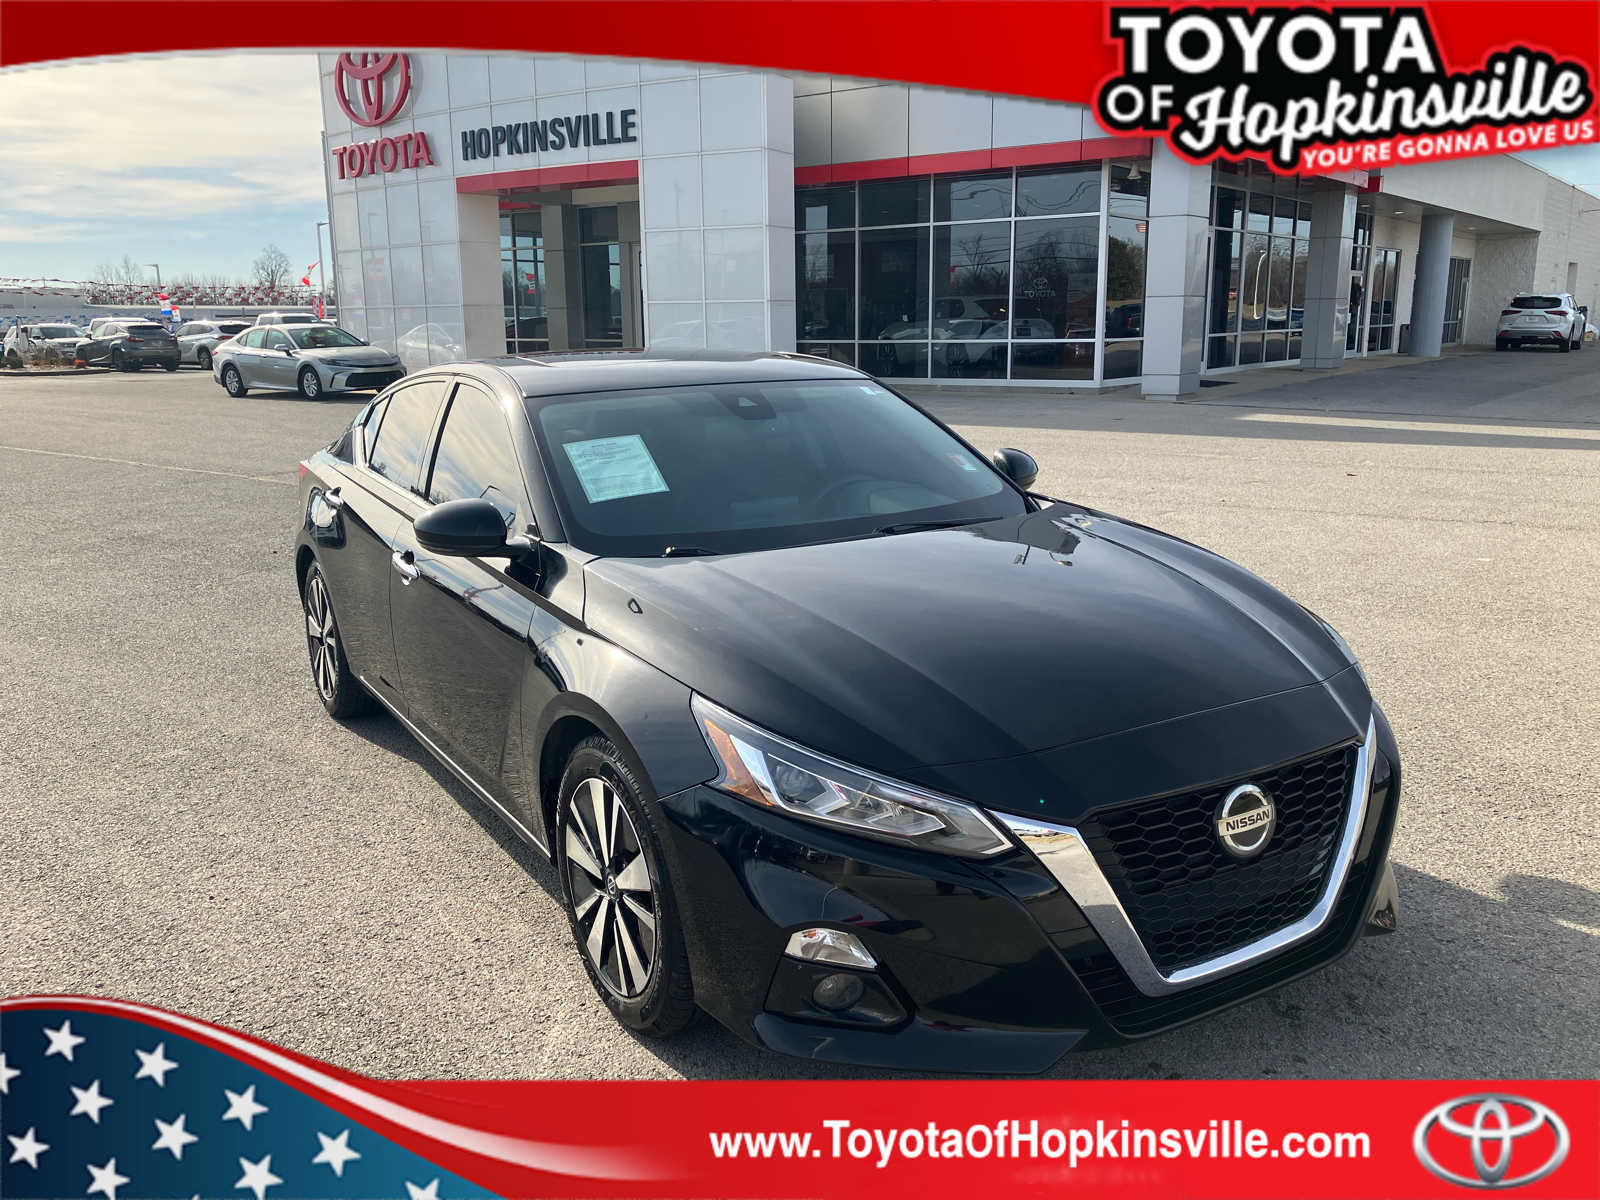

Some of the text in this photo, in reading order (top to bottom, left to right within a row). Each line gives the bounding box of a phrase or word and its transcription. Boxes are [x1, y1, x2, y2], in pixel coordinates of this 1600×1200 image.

[332, 131, 434, 180] TOYOTA
[461, 109, 637, 161] HOPKINSVILLE
[1226, 809, 1270, 831] NISSAN
